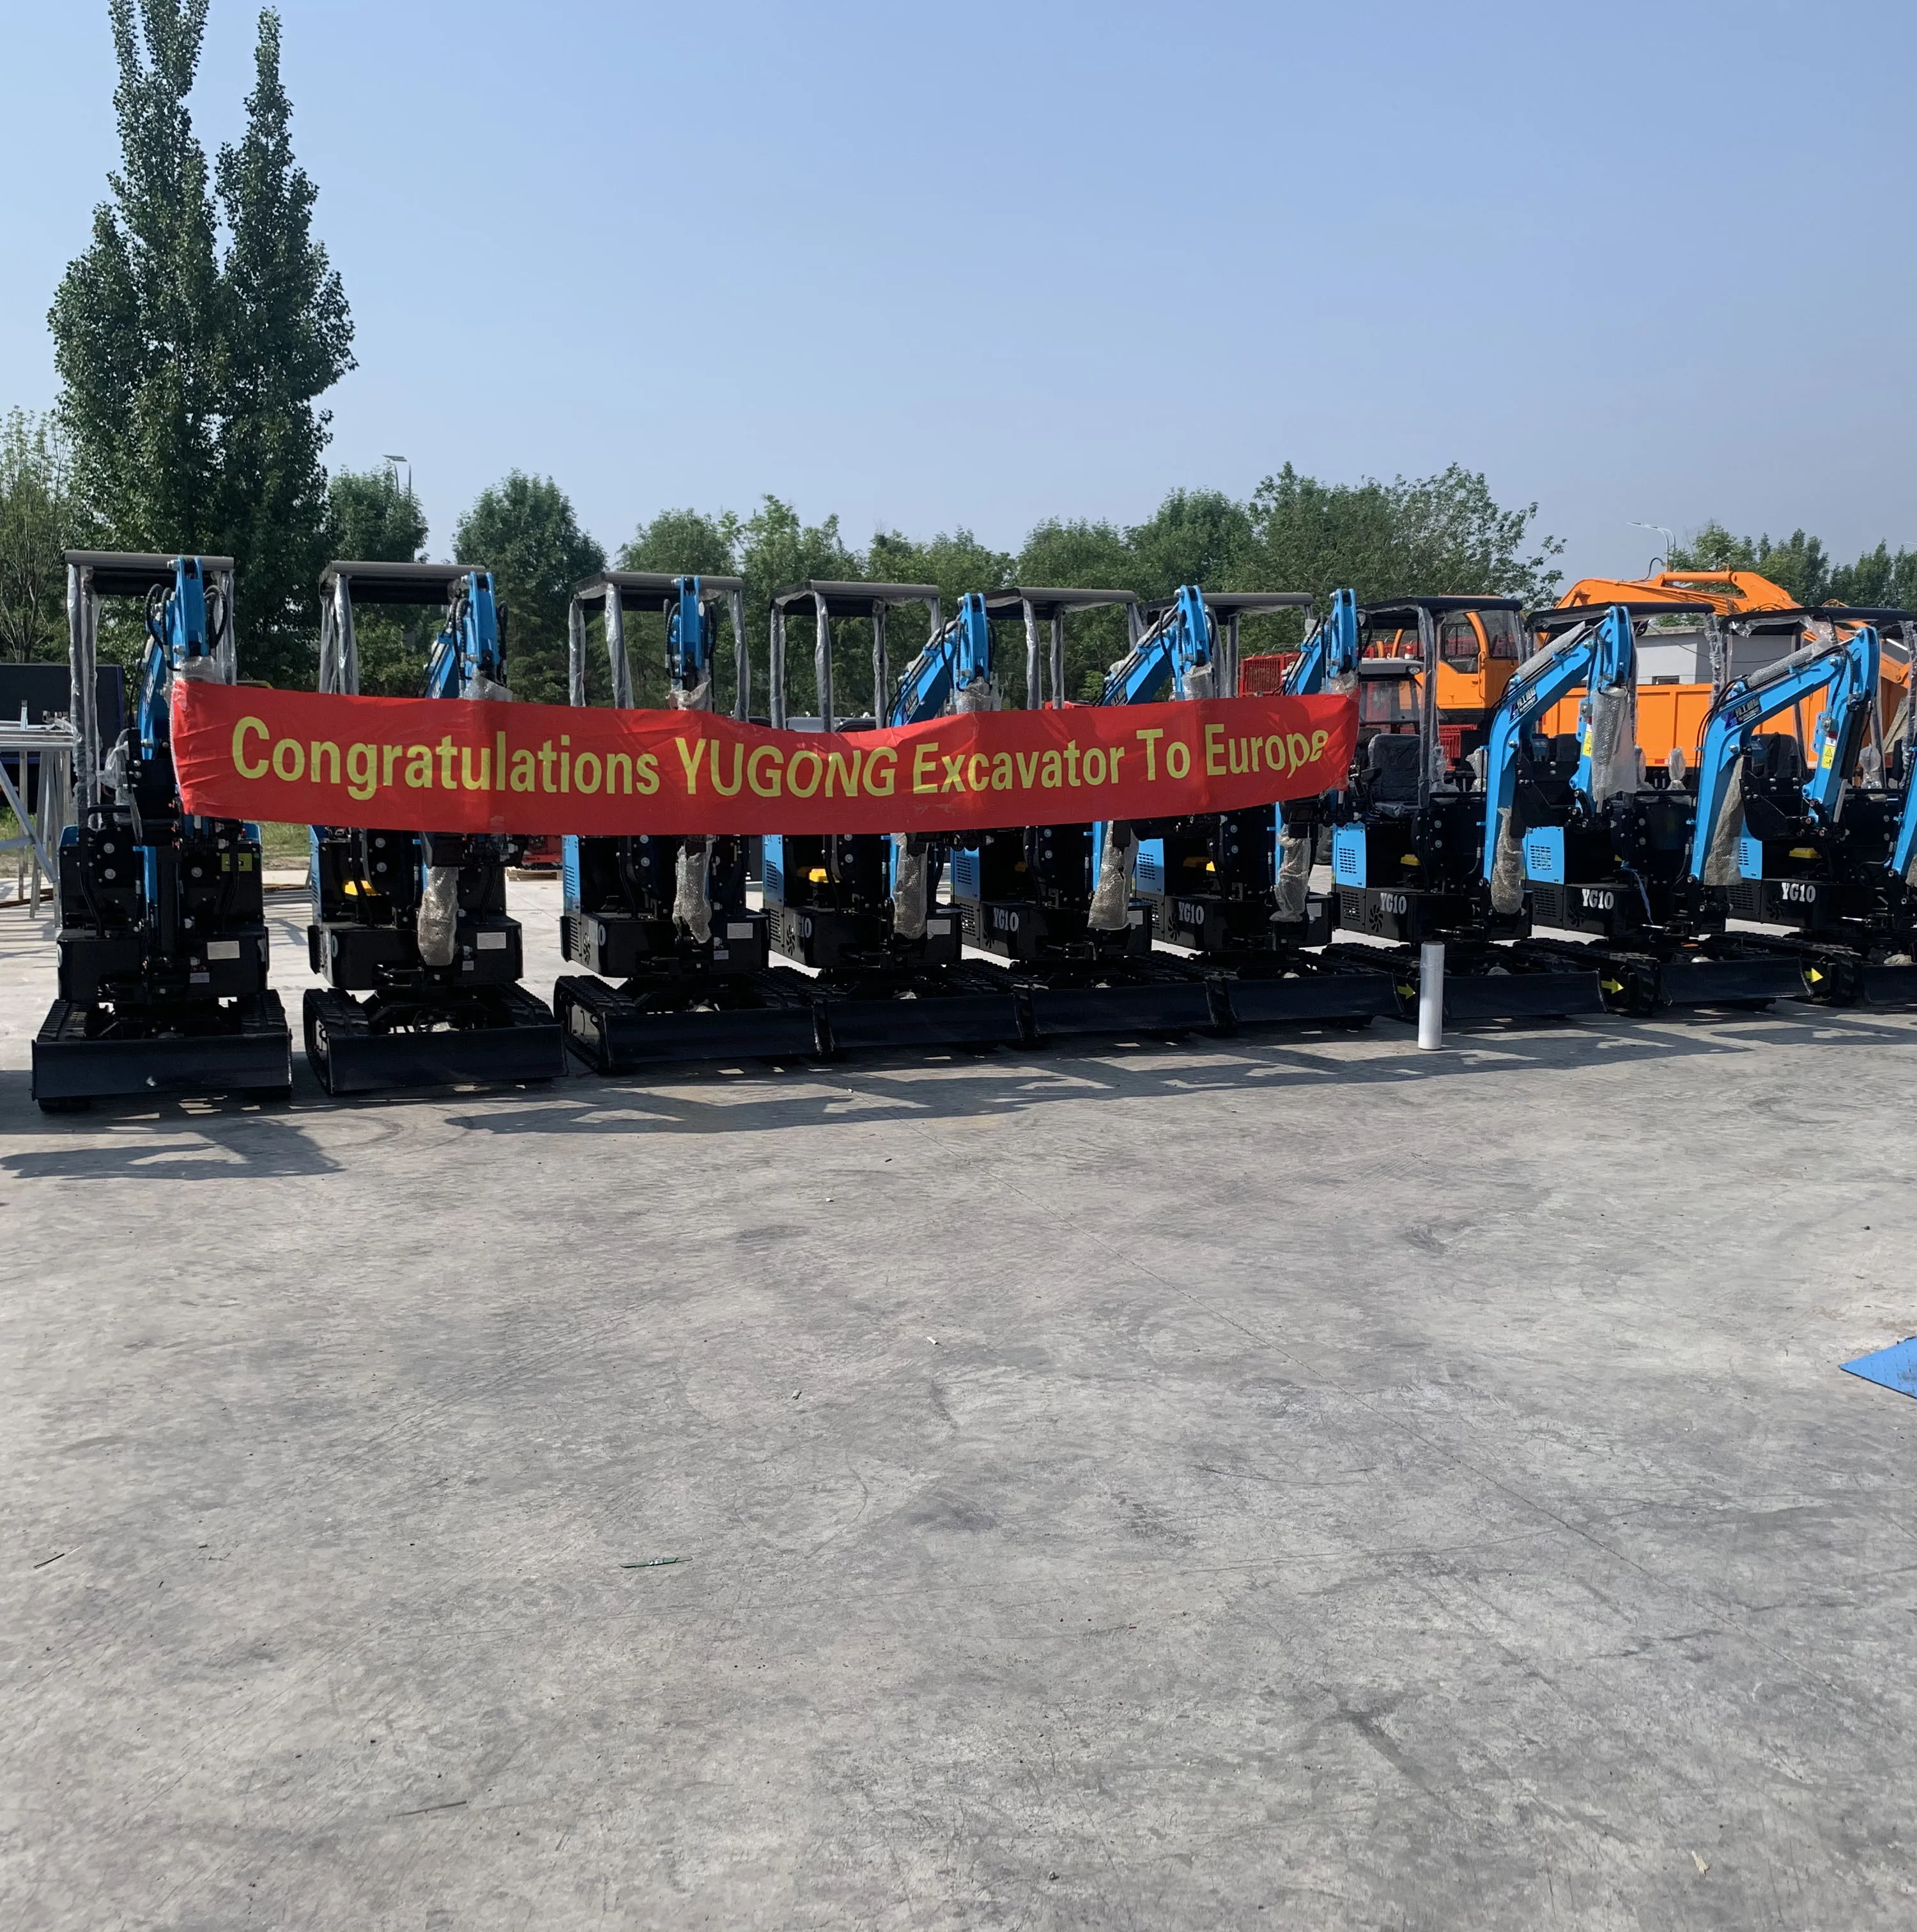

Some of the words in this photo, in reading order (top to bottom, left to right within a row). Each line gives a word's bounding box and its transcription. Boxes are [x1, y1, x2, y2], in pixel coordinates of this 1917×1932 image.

[231, 716, 660, 801] Congratulations
[675, 737, 898, 797] YUGONG
[912, 740, 1125, 794] Excavator
[1136, 728, 1190, 781] To
[1205, 724, 1329, 779] Europe
[1380, 892, 1407, 914] YG10
[1582, 888, 1614, 910] YG10
[1781, 882, 1816, 903] YG10
[993, 907, 1019, 931] YG10
[1178, 901, 1205, 924] YG10
